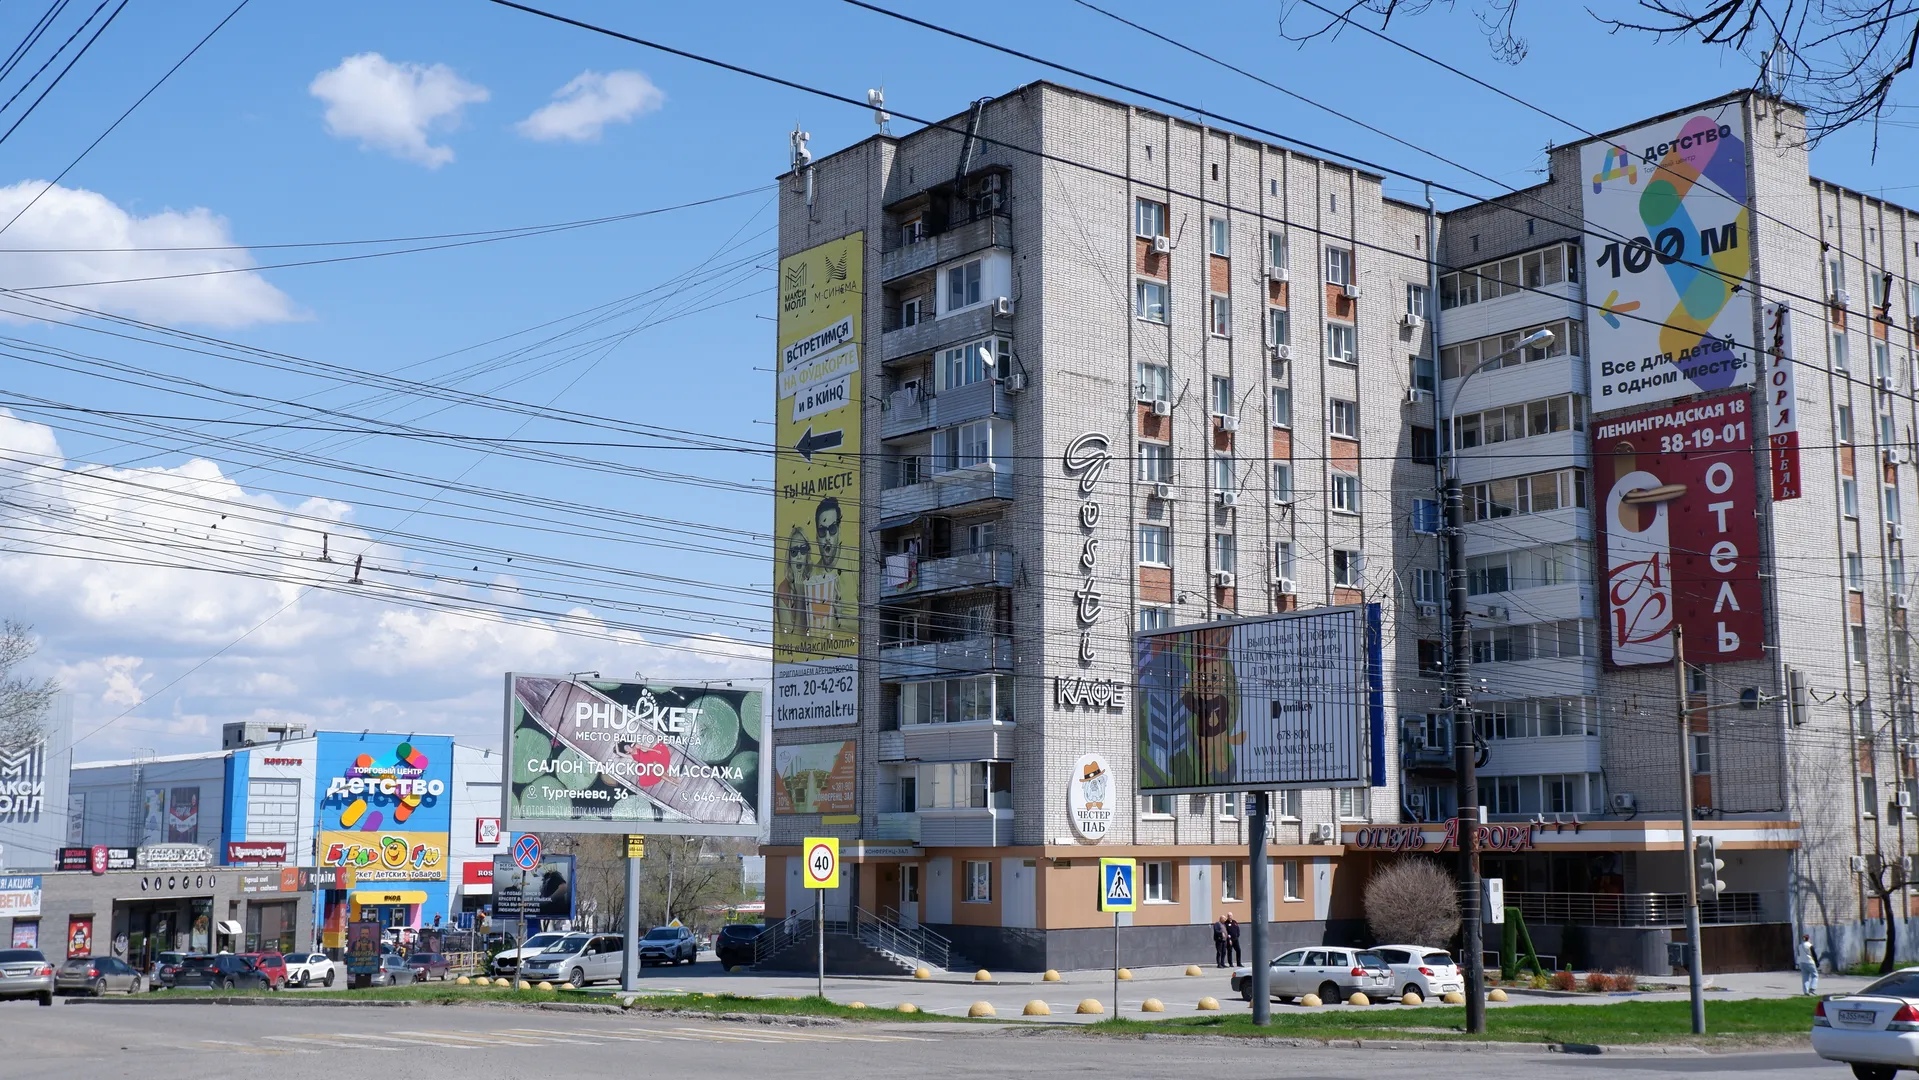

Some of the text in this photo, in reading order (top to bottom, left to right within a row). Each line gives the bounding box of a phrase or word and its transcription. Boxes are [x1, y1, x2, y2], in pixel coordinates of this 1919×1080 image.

[1643, 124, 1731, 165] детство
[1596, 227, 1685, 278] 100
[785, 288, 807, 303] МАКСИ
[785, 297, 807, 312] МОЛЛ
[787, 321, 849, 364] ВСТРЕТИМСЯ
[1601, 333, 1736, 378] Все для детей
[783, 350, 855, 391] НА ФУДКОРТЕ
[1602, 353, 1748, 397] в одном месте!
[807, 394, 814, 410] В
[816, 384, 844, 406] КИНО
[1597, 400, 1745, 440] ЛЕНИНГРАДСКАЯ 18
[1660, 421, 1746, 454] 38-19-01
[783, 472, 853, 500] ТЫ НА МЕСТЕ
[779, 676, 853, 698] тел. 20-42-62
[1056, 678, 1126, 706] КАФЕ
[778, 700, 854, 721] tkmaximall.ru
[576, 731, 702, 746] МЕСТО ВАШЕГО РЕЛАКСА
[354, 767, 423, 775] ТОРГОВЫЙ ЦЕНТР
[528, 758, 744, 780] САЛОН ТАЙСКОГО МАССАЖА
[326, 777, 444, 798] детство
[542, 786, 629, 801] Тургенева, 36
[693, 791, 744, 803] 646-444
[1077, 810, 1111, 820] ЧЕСТЕР
[1082, 822, 1106, 833] ПАБ
[1356, 818, 1534, 852] ОТЕЛЬ АРОРА
[814, 856, 829, 871] 40
[8, 877, 34, 889] АКЦИЯ!
